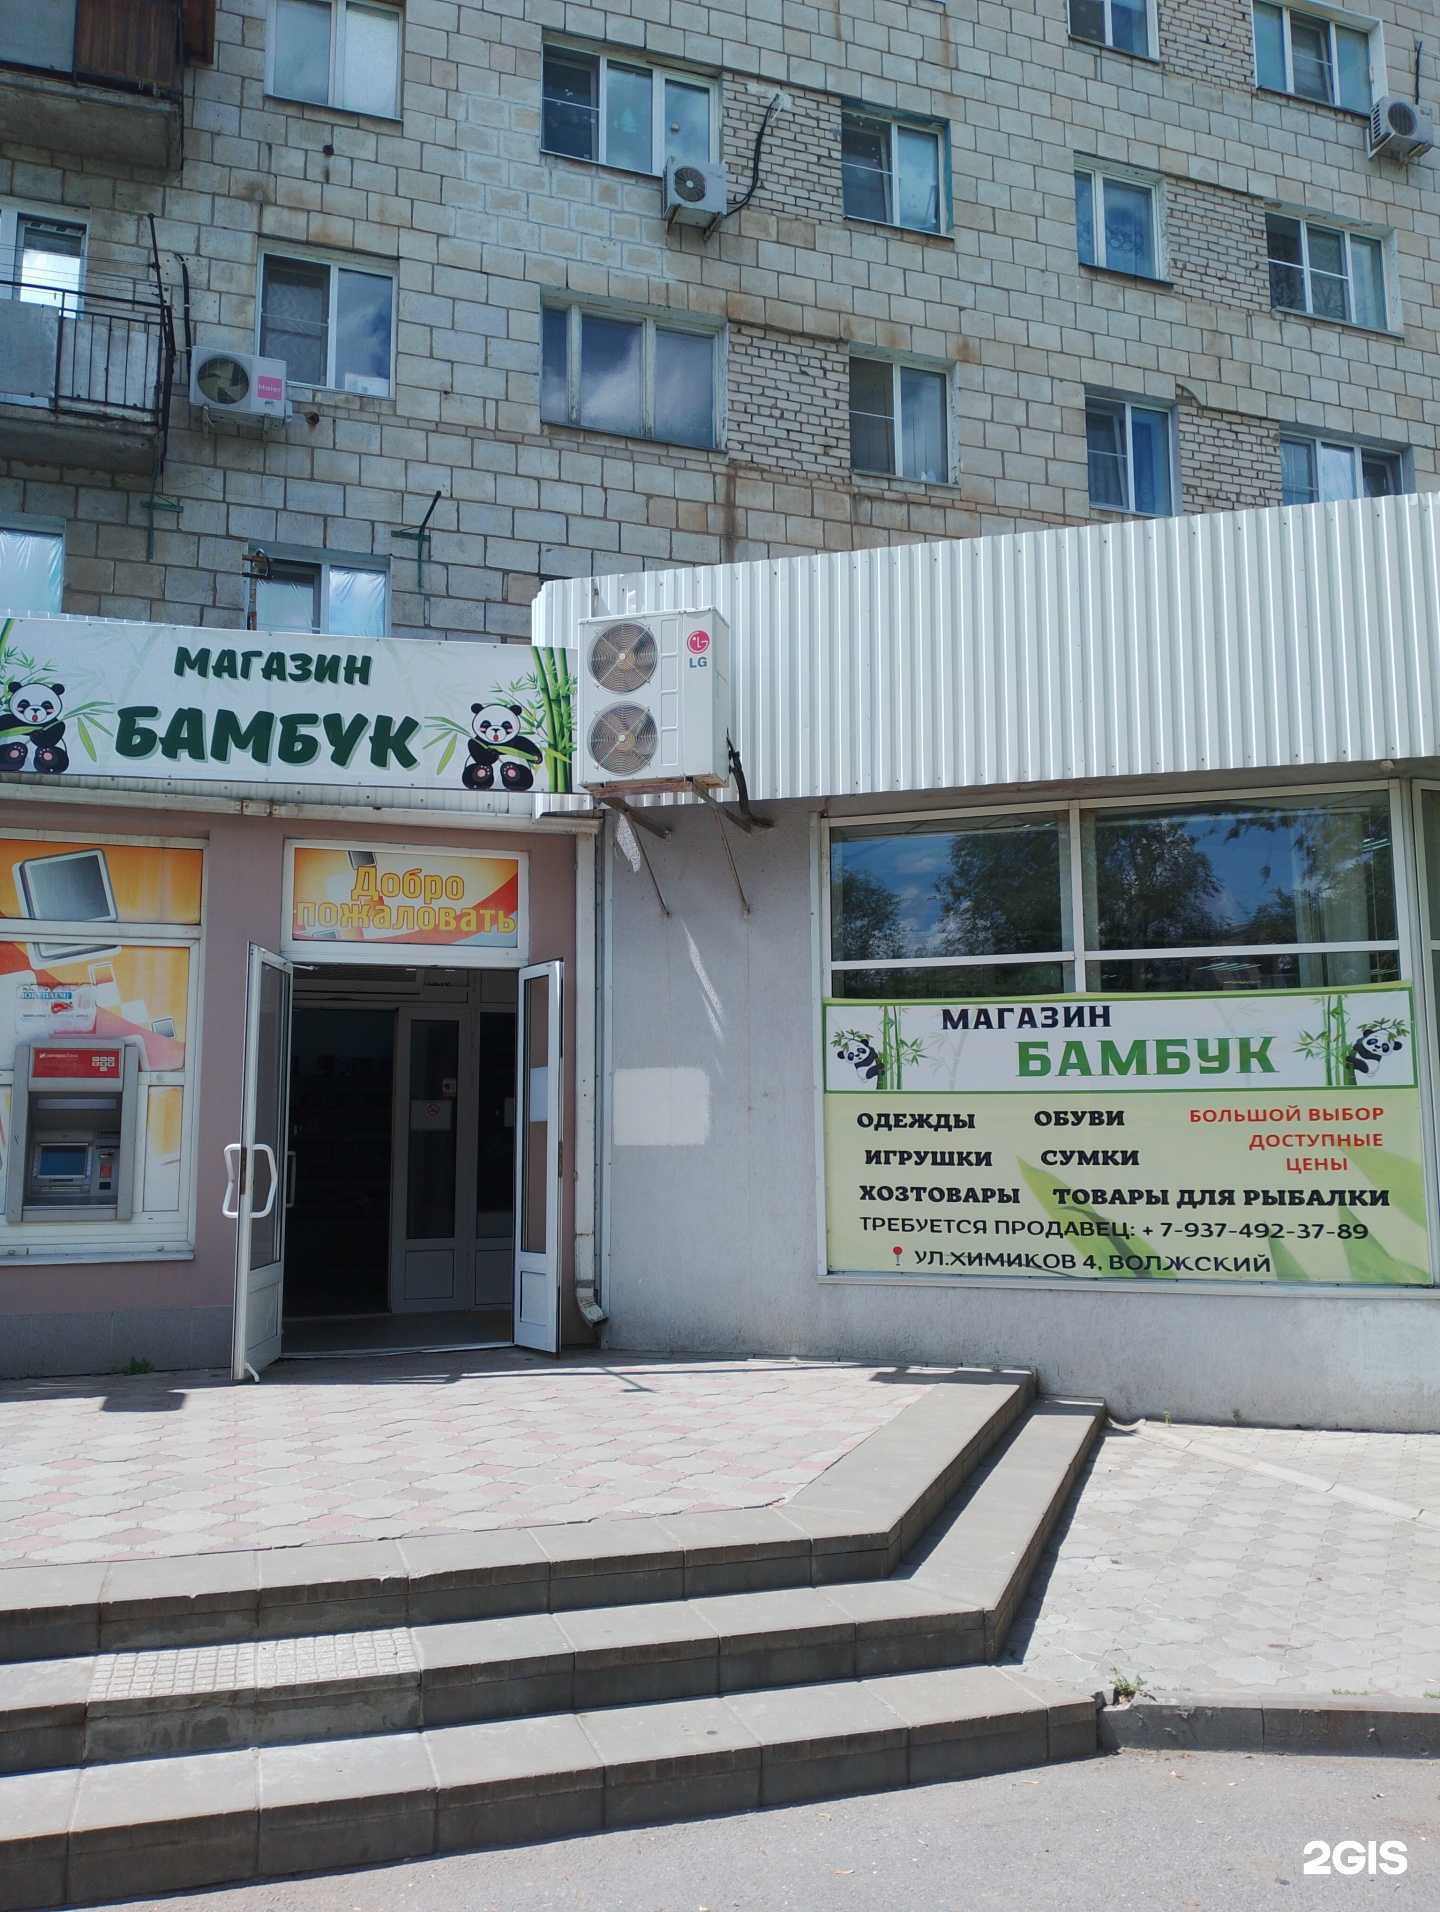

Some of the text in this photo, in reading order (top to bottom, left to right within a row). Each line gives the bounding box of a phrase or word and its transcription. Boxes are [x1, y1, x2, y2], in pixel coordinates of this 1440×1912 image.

[174, 646, 372, 687] МАГАЗИН
[689, 656, 708, 668] LG
[115, 705, 421, 770] БАМБУК
[350, 864, 466, 904] Добро
[942, 1005, 1112, 1030] МАГАЗИН
[1017, 1037, 1279, 1077] БАМБУК
[856, 1112, 977, 1132] ОДЕЖДЫ
[1033, 1110, 1126, 1127] ОБУВИ
[1189, 1105, 1385, 1123] БОЛЬШОЙ ВЫБОР
[1248, 1133, 1384, 1151] ДОСТУПНЫЕ
[864, 1150, 993, 1167] ИГРУШКИ
[1040, 1150, 1140, 1166] СУМКИ
[1285, 1157, 1349, 1174] ЦЕНЫ
[859, 1185, 1020, 1205] ХОЗТОВАРЫ
[1053, 1188, 1391, 1209] ТОВАРЫ ДЛЯ РЫБАЛКИ
[859, 1216, 988, 1235] ТРЕБУЕТСЯ
[995, 1219, 1136, 1240] ПРОДАВЕЦ:
[914, 1249, 1077, 1270] УЛ.ХИМИКОВ
[1109, 1253, 1271, 1272] ВОЛЖСКИЙ
